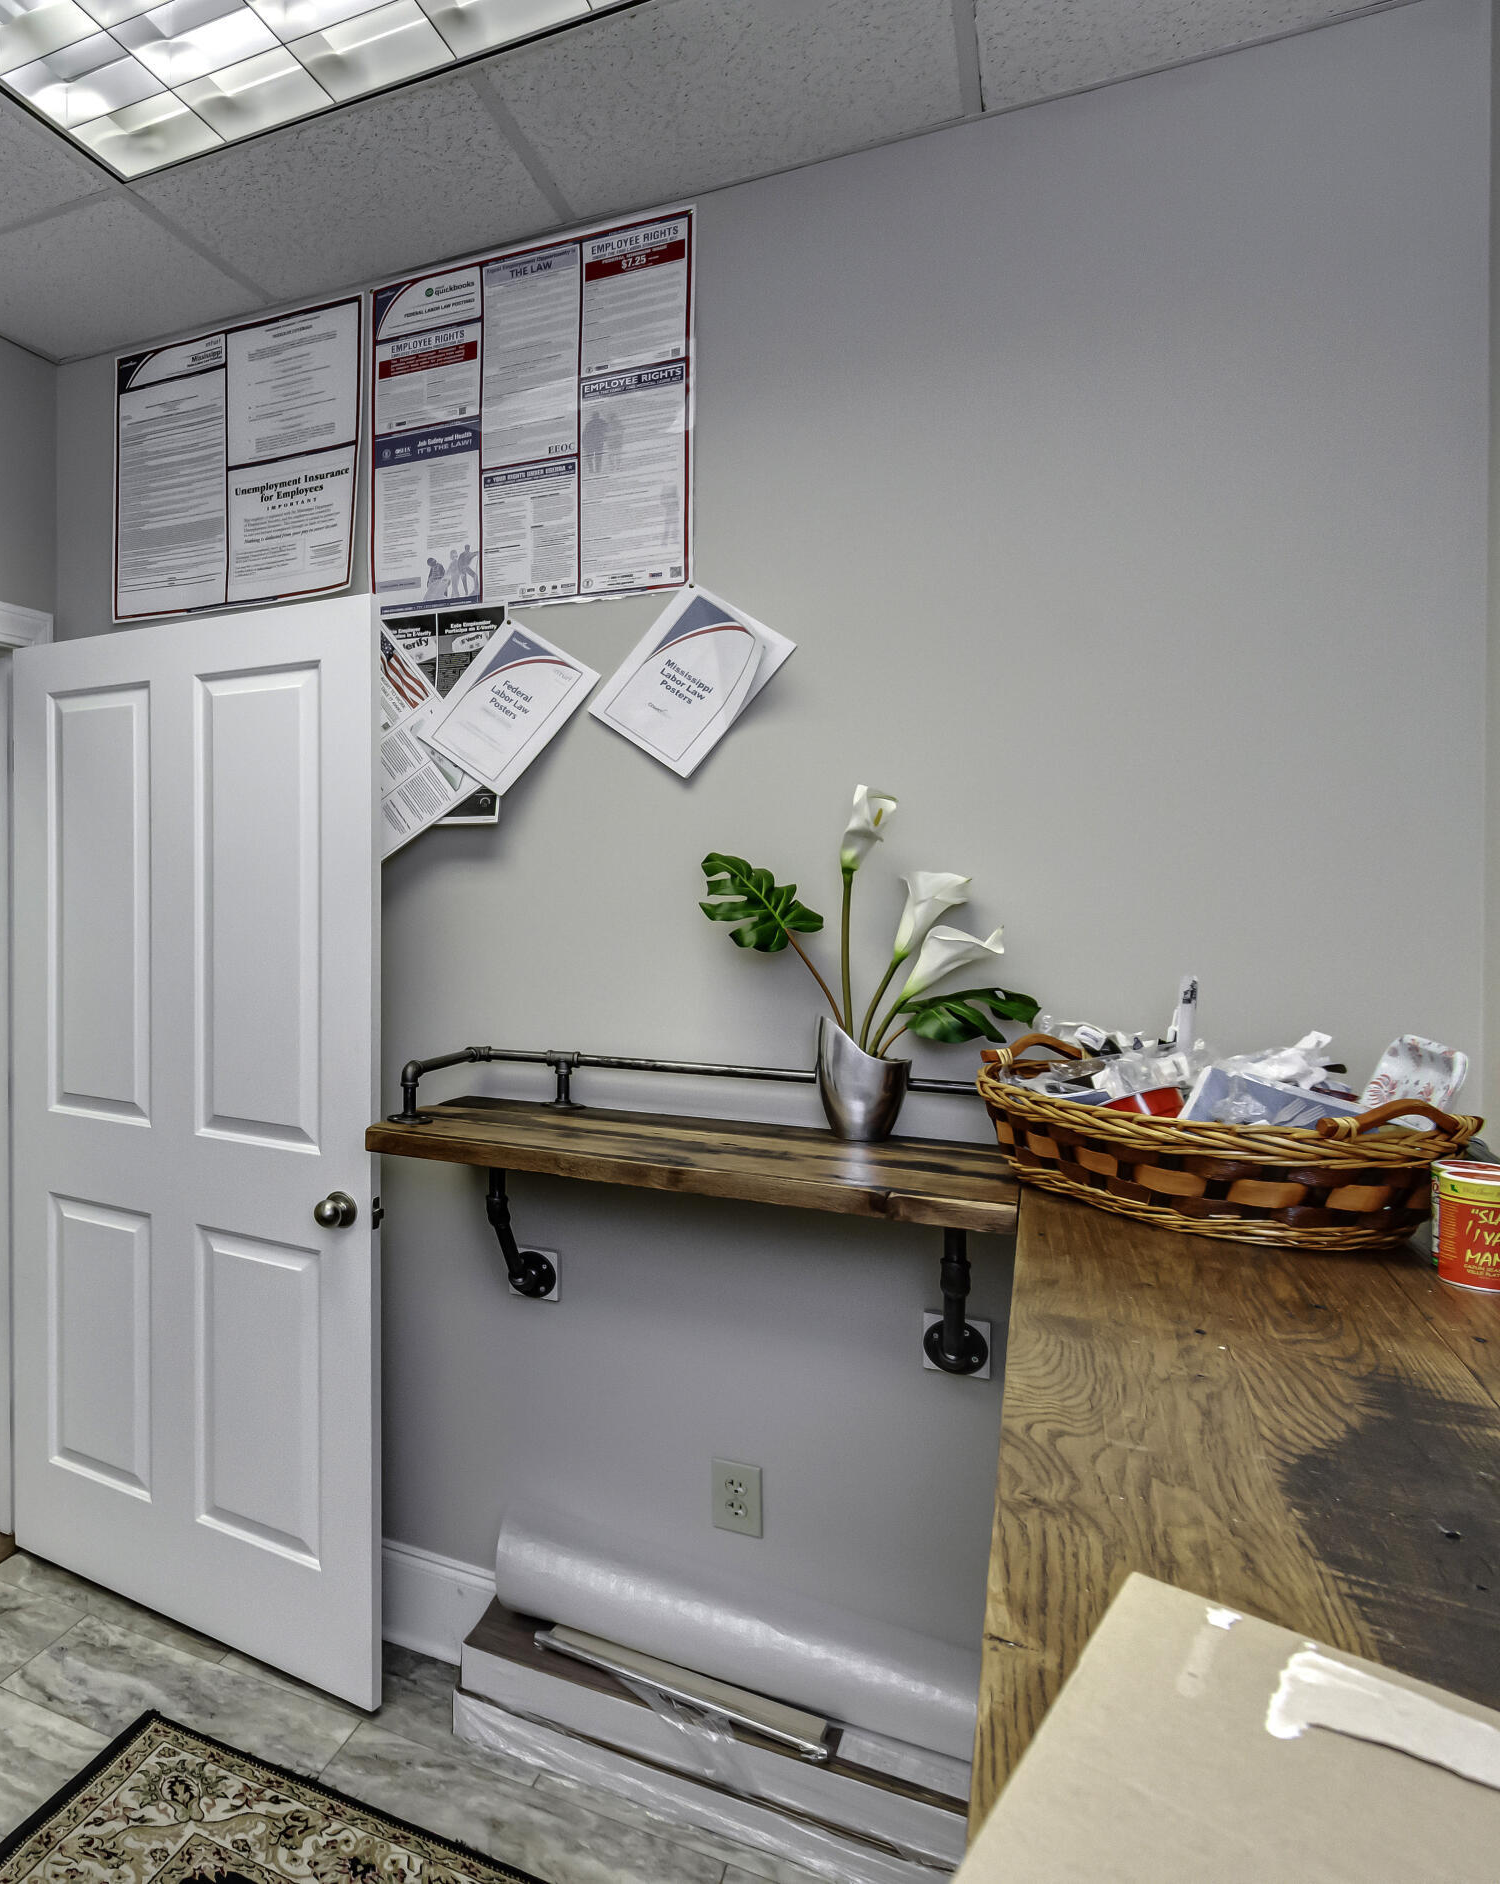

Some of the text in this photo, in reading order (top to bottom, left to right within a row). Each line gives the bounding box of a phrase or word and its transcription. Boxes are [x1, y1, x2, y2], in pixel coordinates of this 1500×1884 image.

[591, 226, 679, 255] EMPLOYEE RIGHTS
[509, 260, 553, 279] THE LAW
[621, 255, 647, 270] $7.25
[434, 281, 475, 296] quickbooks
[391, 329, 465, 354] EMPLOYEE RIGHTS
[584, 367, 682, 393] EMPLOYEE RIGHTS
[417, 440, 427, 448] Job
[427, 437, 443, 446] Safety
[454, 431, 472, 440] Health
[433, 443, 449, 451] THE
[450, 439, 472, 448] LAW!
[548, 442, 575, 454] EEOC
[235, 467, 350, 496] Unemployment Insurance
[492, 475, 507, 483] YOUR
[507, 472, 526, 480] RIGHTS
[526, 468, 544, 477] UNDER
[260, 484, 324, 503] for Employees
[266, 497, 317, 511] IMPORTANT
[660, 667, 706, 701] Labor Law
[664, 659, 714, 694] Mississippi
[491, 685, 530, 715] Labor Law
[502, 680, 533, 703] Federal
[660, 679, 693, 705] Posters
[489, 697, 517, 720] Posters
